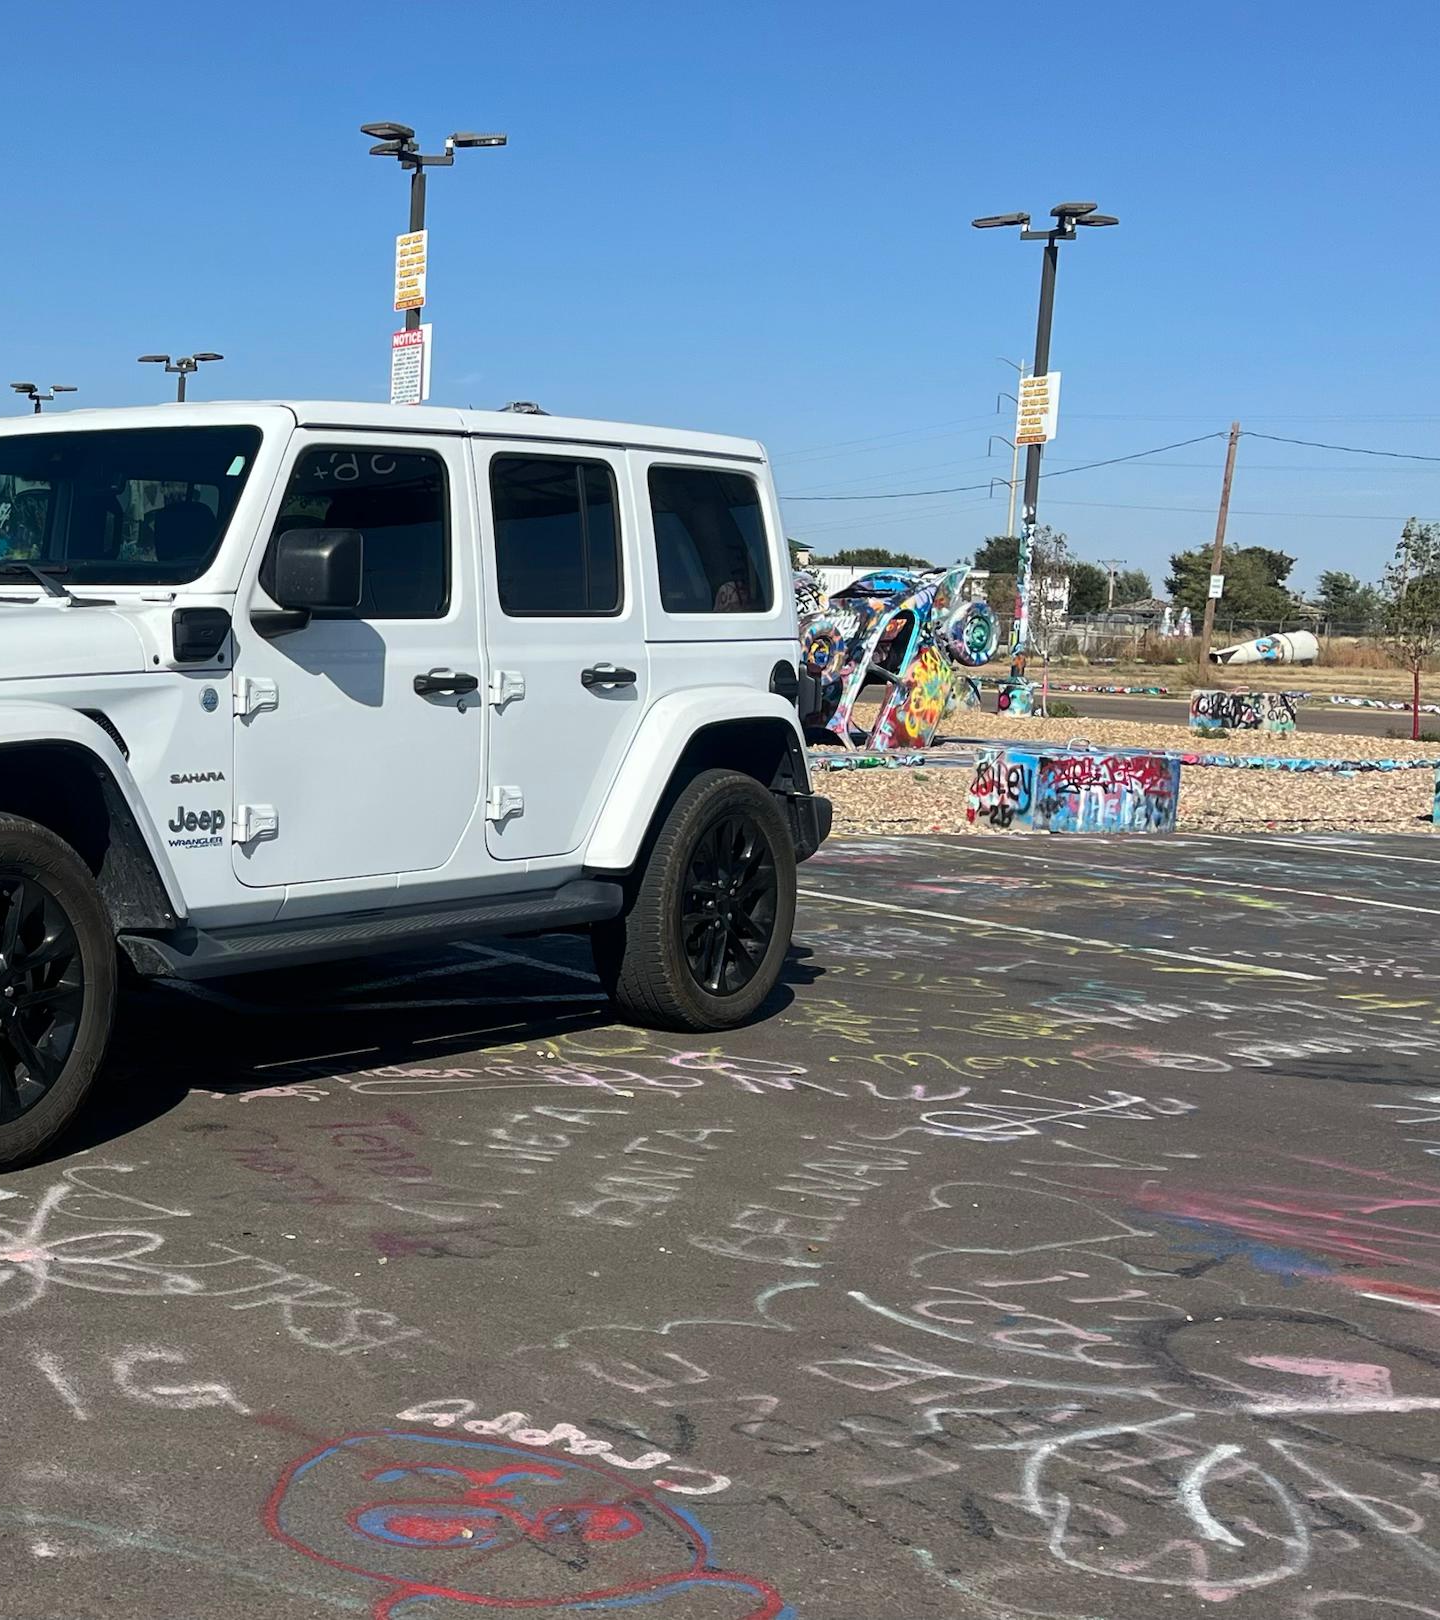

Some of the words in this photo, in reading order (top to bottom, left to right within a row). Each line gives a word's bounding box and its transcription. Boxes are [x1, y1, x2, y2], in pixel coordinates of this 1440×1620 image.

[393, 331, 423, 347] NOTICE
[169, 771, 225, 785] SAHARA
[168, 806, 225, 834] Jeep
[168, 836, 223, 848] WRANGLER
